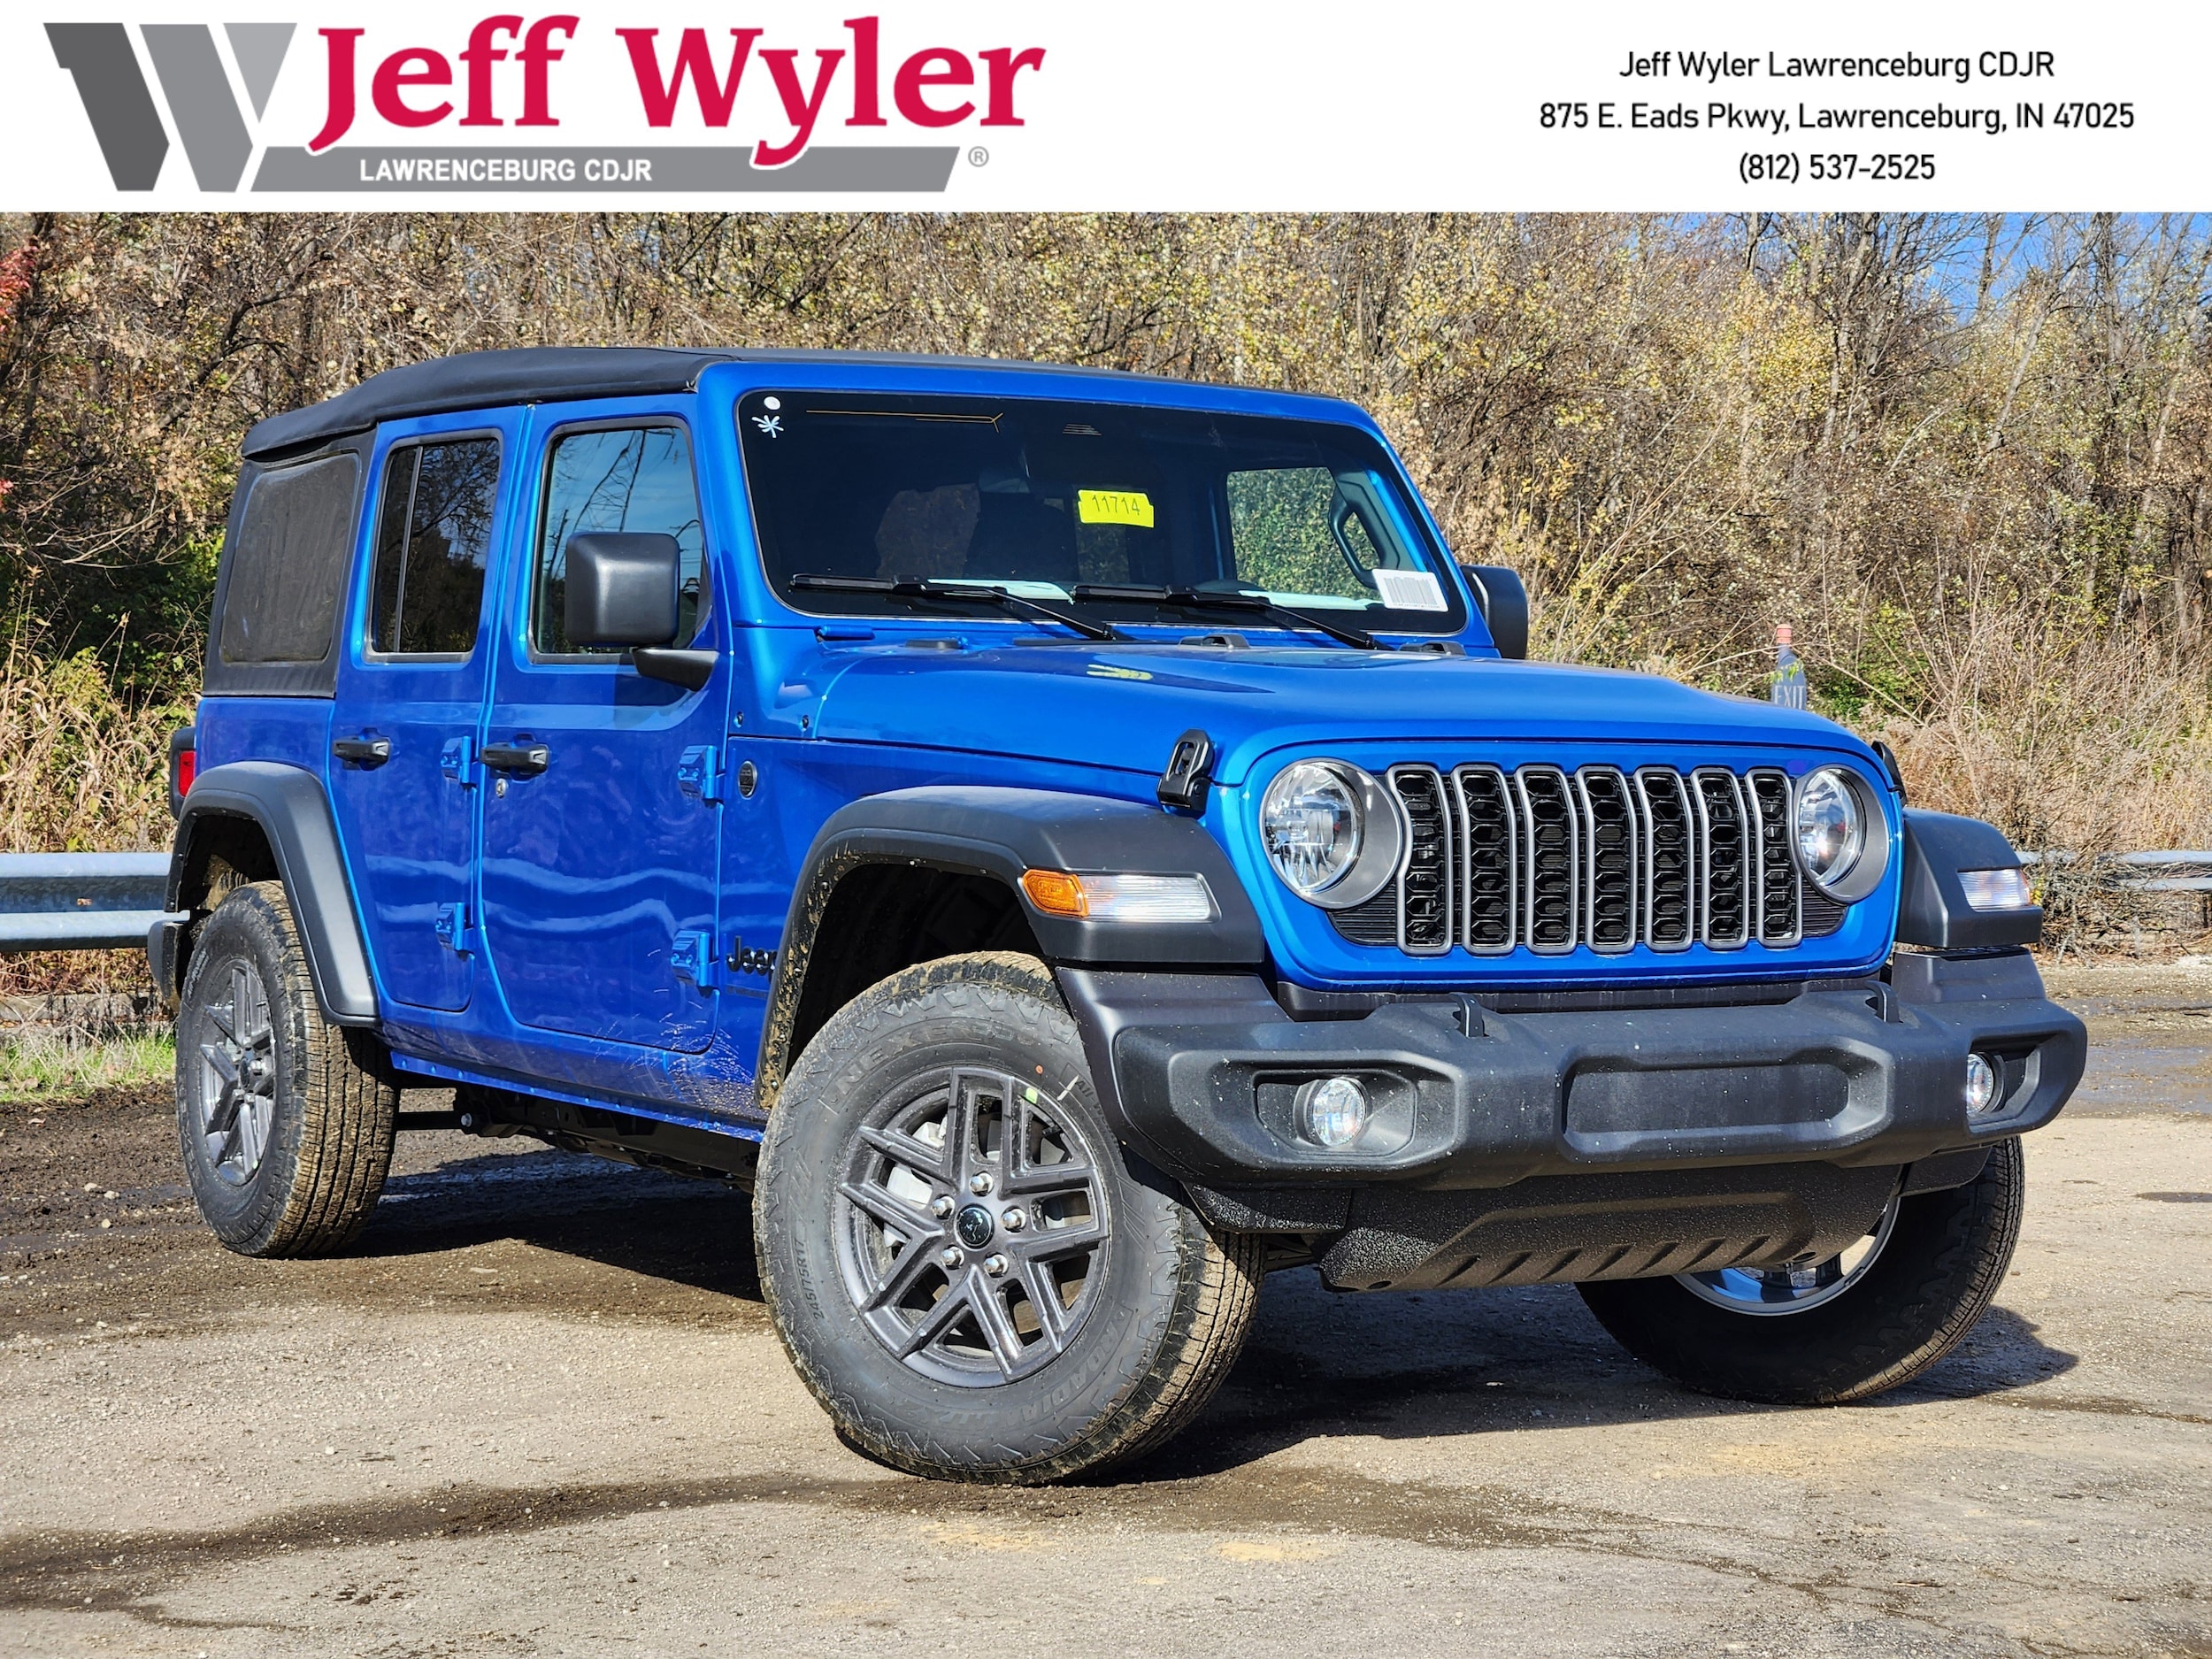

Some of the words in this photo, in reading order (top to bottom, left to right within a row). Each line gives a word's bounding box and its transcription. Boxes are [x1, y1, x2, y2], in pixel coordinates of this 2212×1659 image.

[1092, 495, 1141, 516] 11714
[1774, 685, 1805, 710] EXIT
[794, 1237, 826, 1321] 245/75R17
